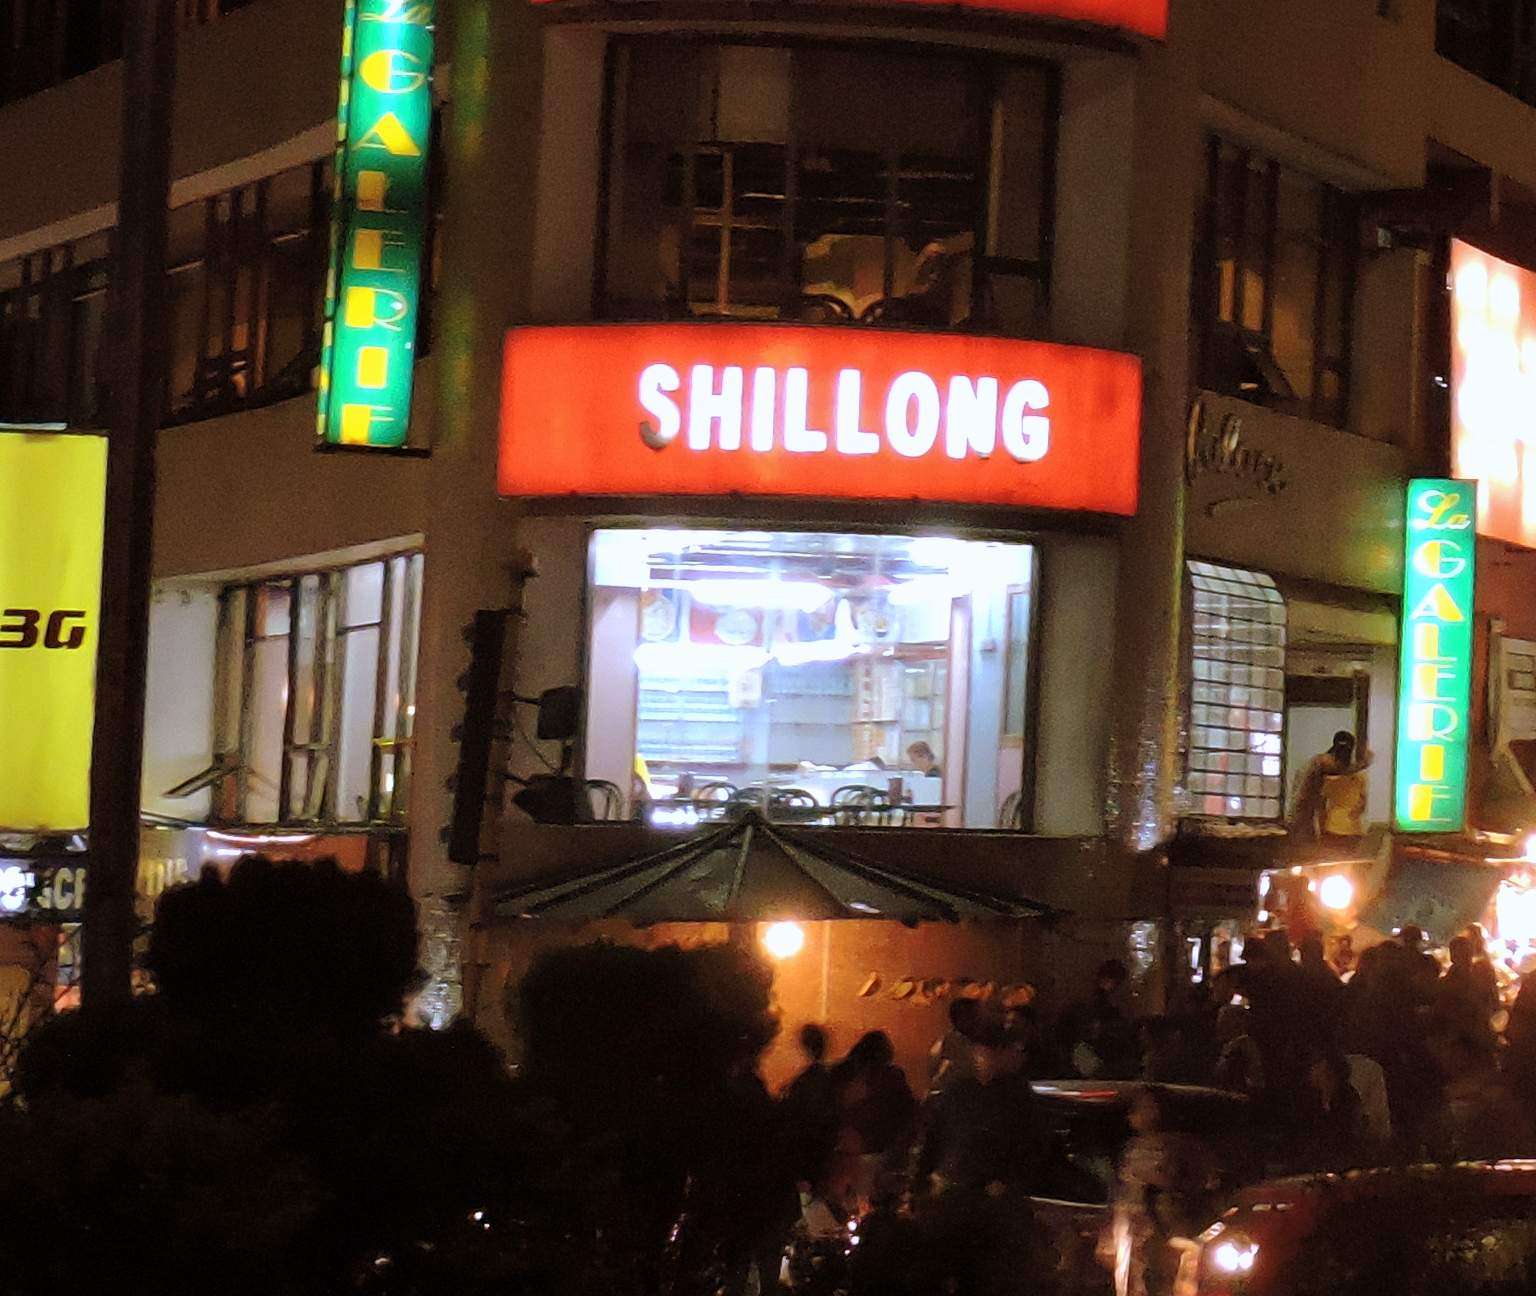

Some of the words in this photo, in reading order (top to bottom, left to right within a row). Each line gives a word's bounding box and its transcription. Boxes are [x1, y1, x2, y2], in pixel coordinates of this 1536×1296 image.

[638, 363, 1050, 462] SHILLONG
[0, 608, 87, 650] 3G
[1407, 538, 1466, 822] GALERIE
